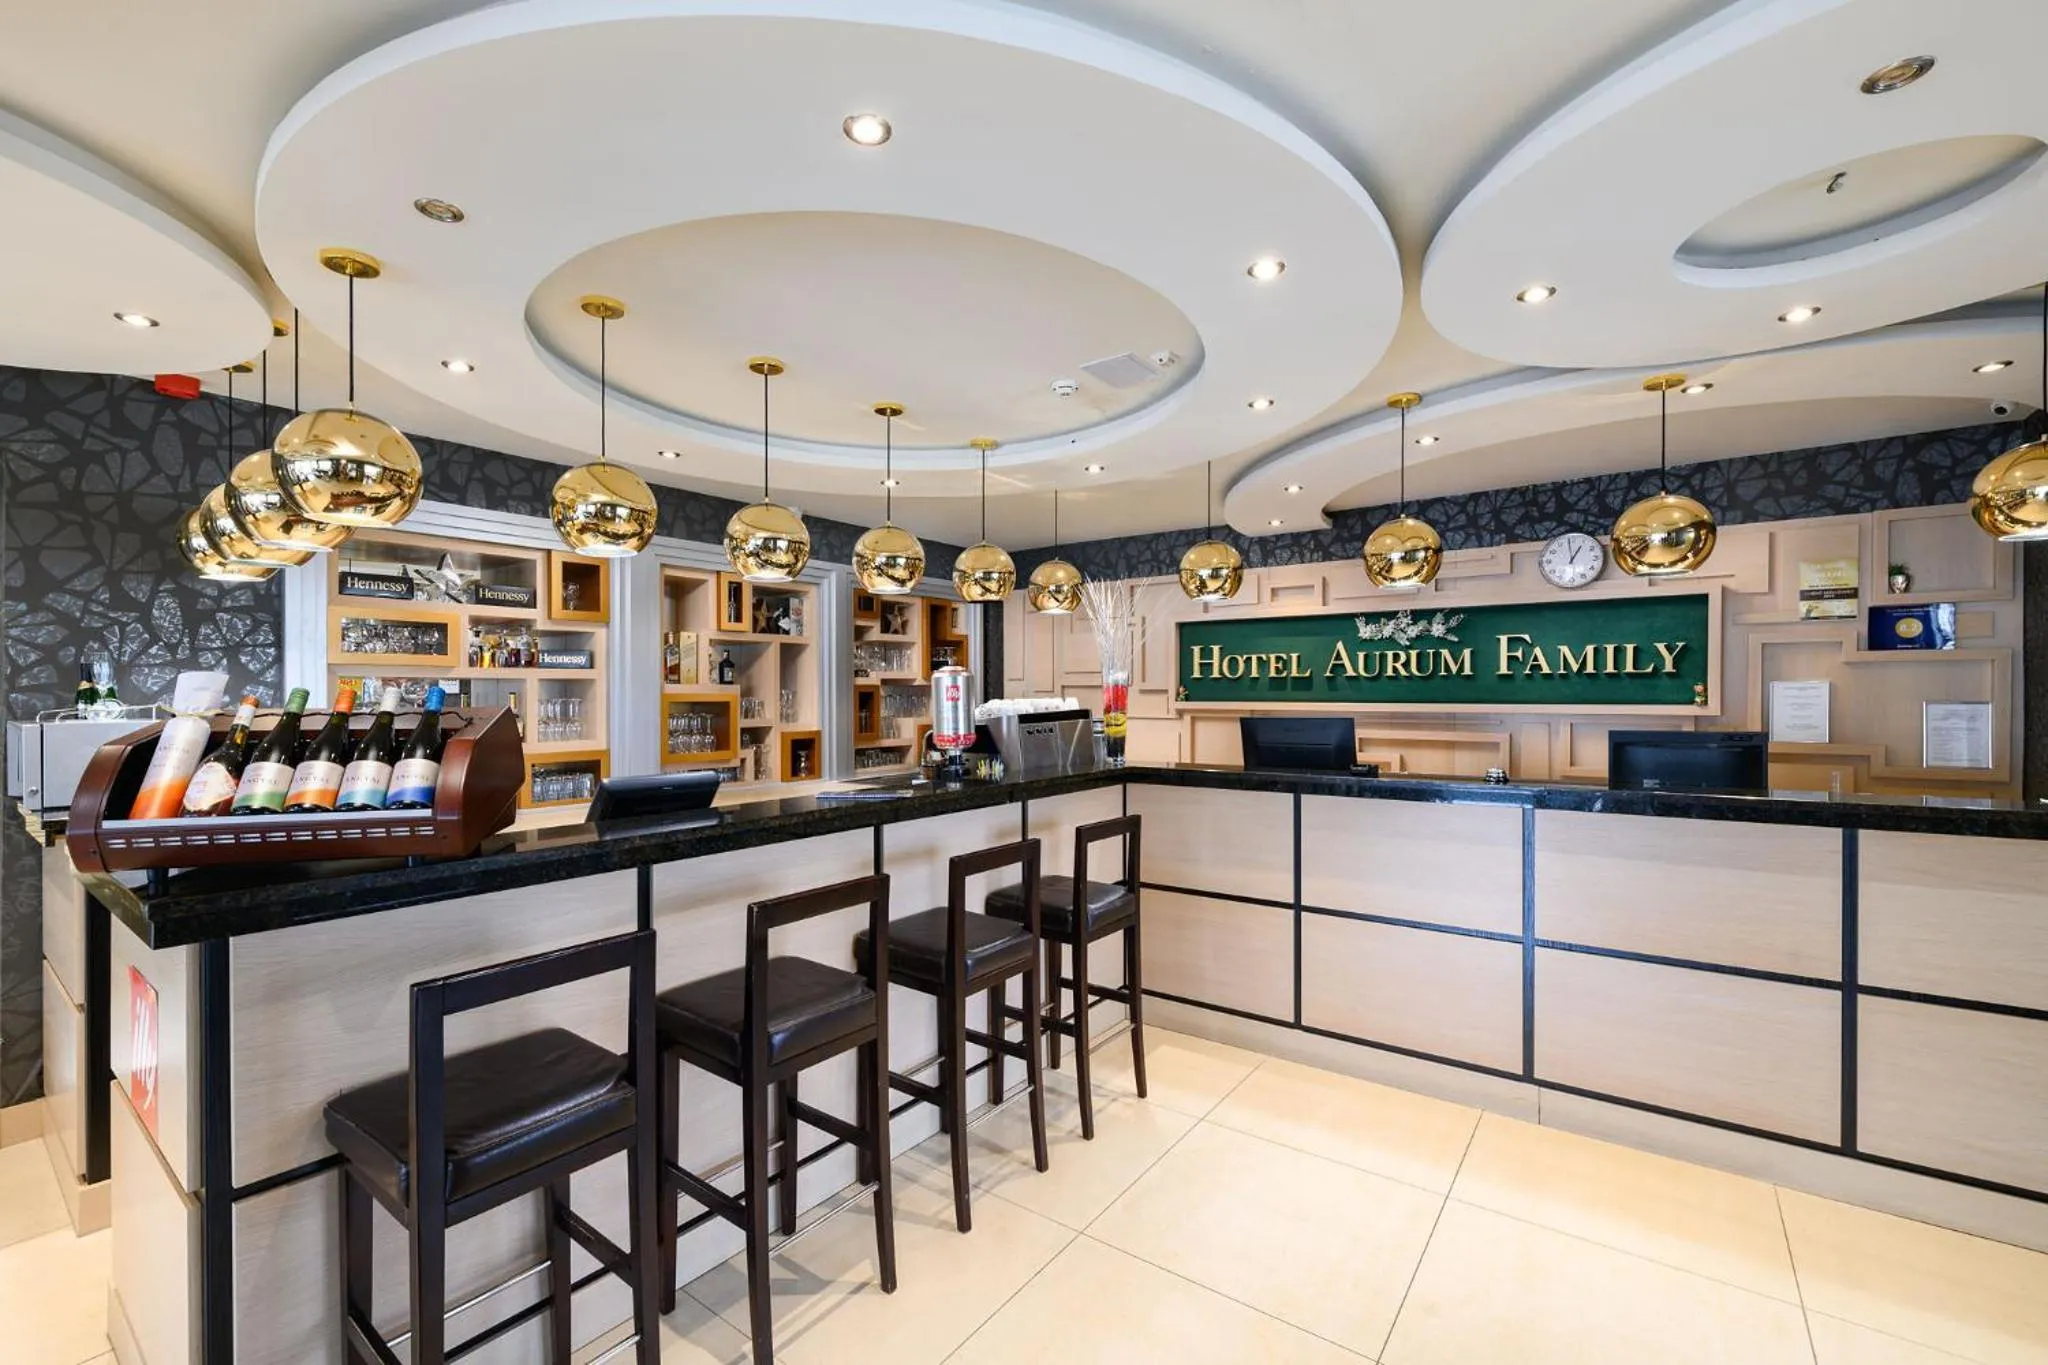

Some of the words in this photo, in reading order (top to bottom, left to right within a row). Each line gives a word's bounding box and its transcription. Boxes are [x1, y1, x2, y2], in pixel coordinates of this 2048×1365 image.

[347, 576, 409, 592] Hennessy
[479, 589, 530, 602] Hennessy
[538, 652, 587, 665] Hennessy
[1190, 644, 1312, 679] HOTEL
[1324, 639, 1474, 677] AURUM
[1496, 633, 1687, 676] FAMILY
